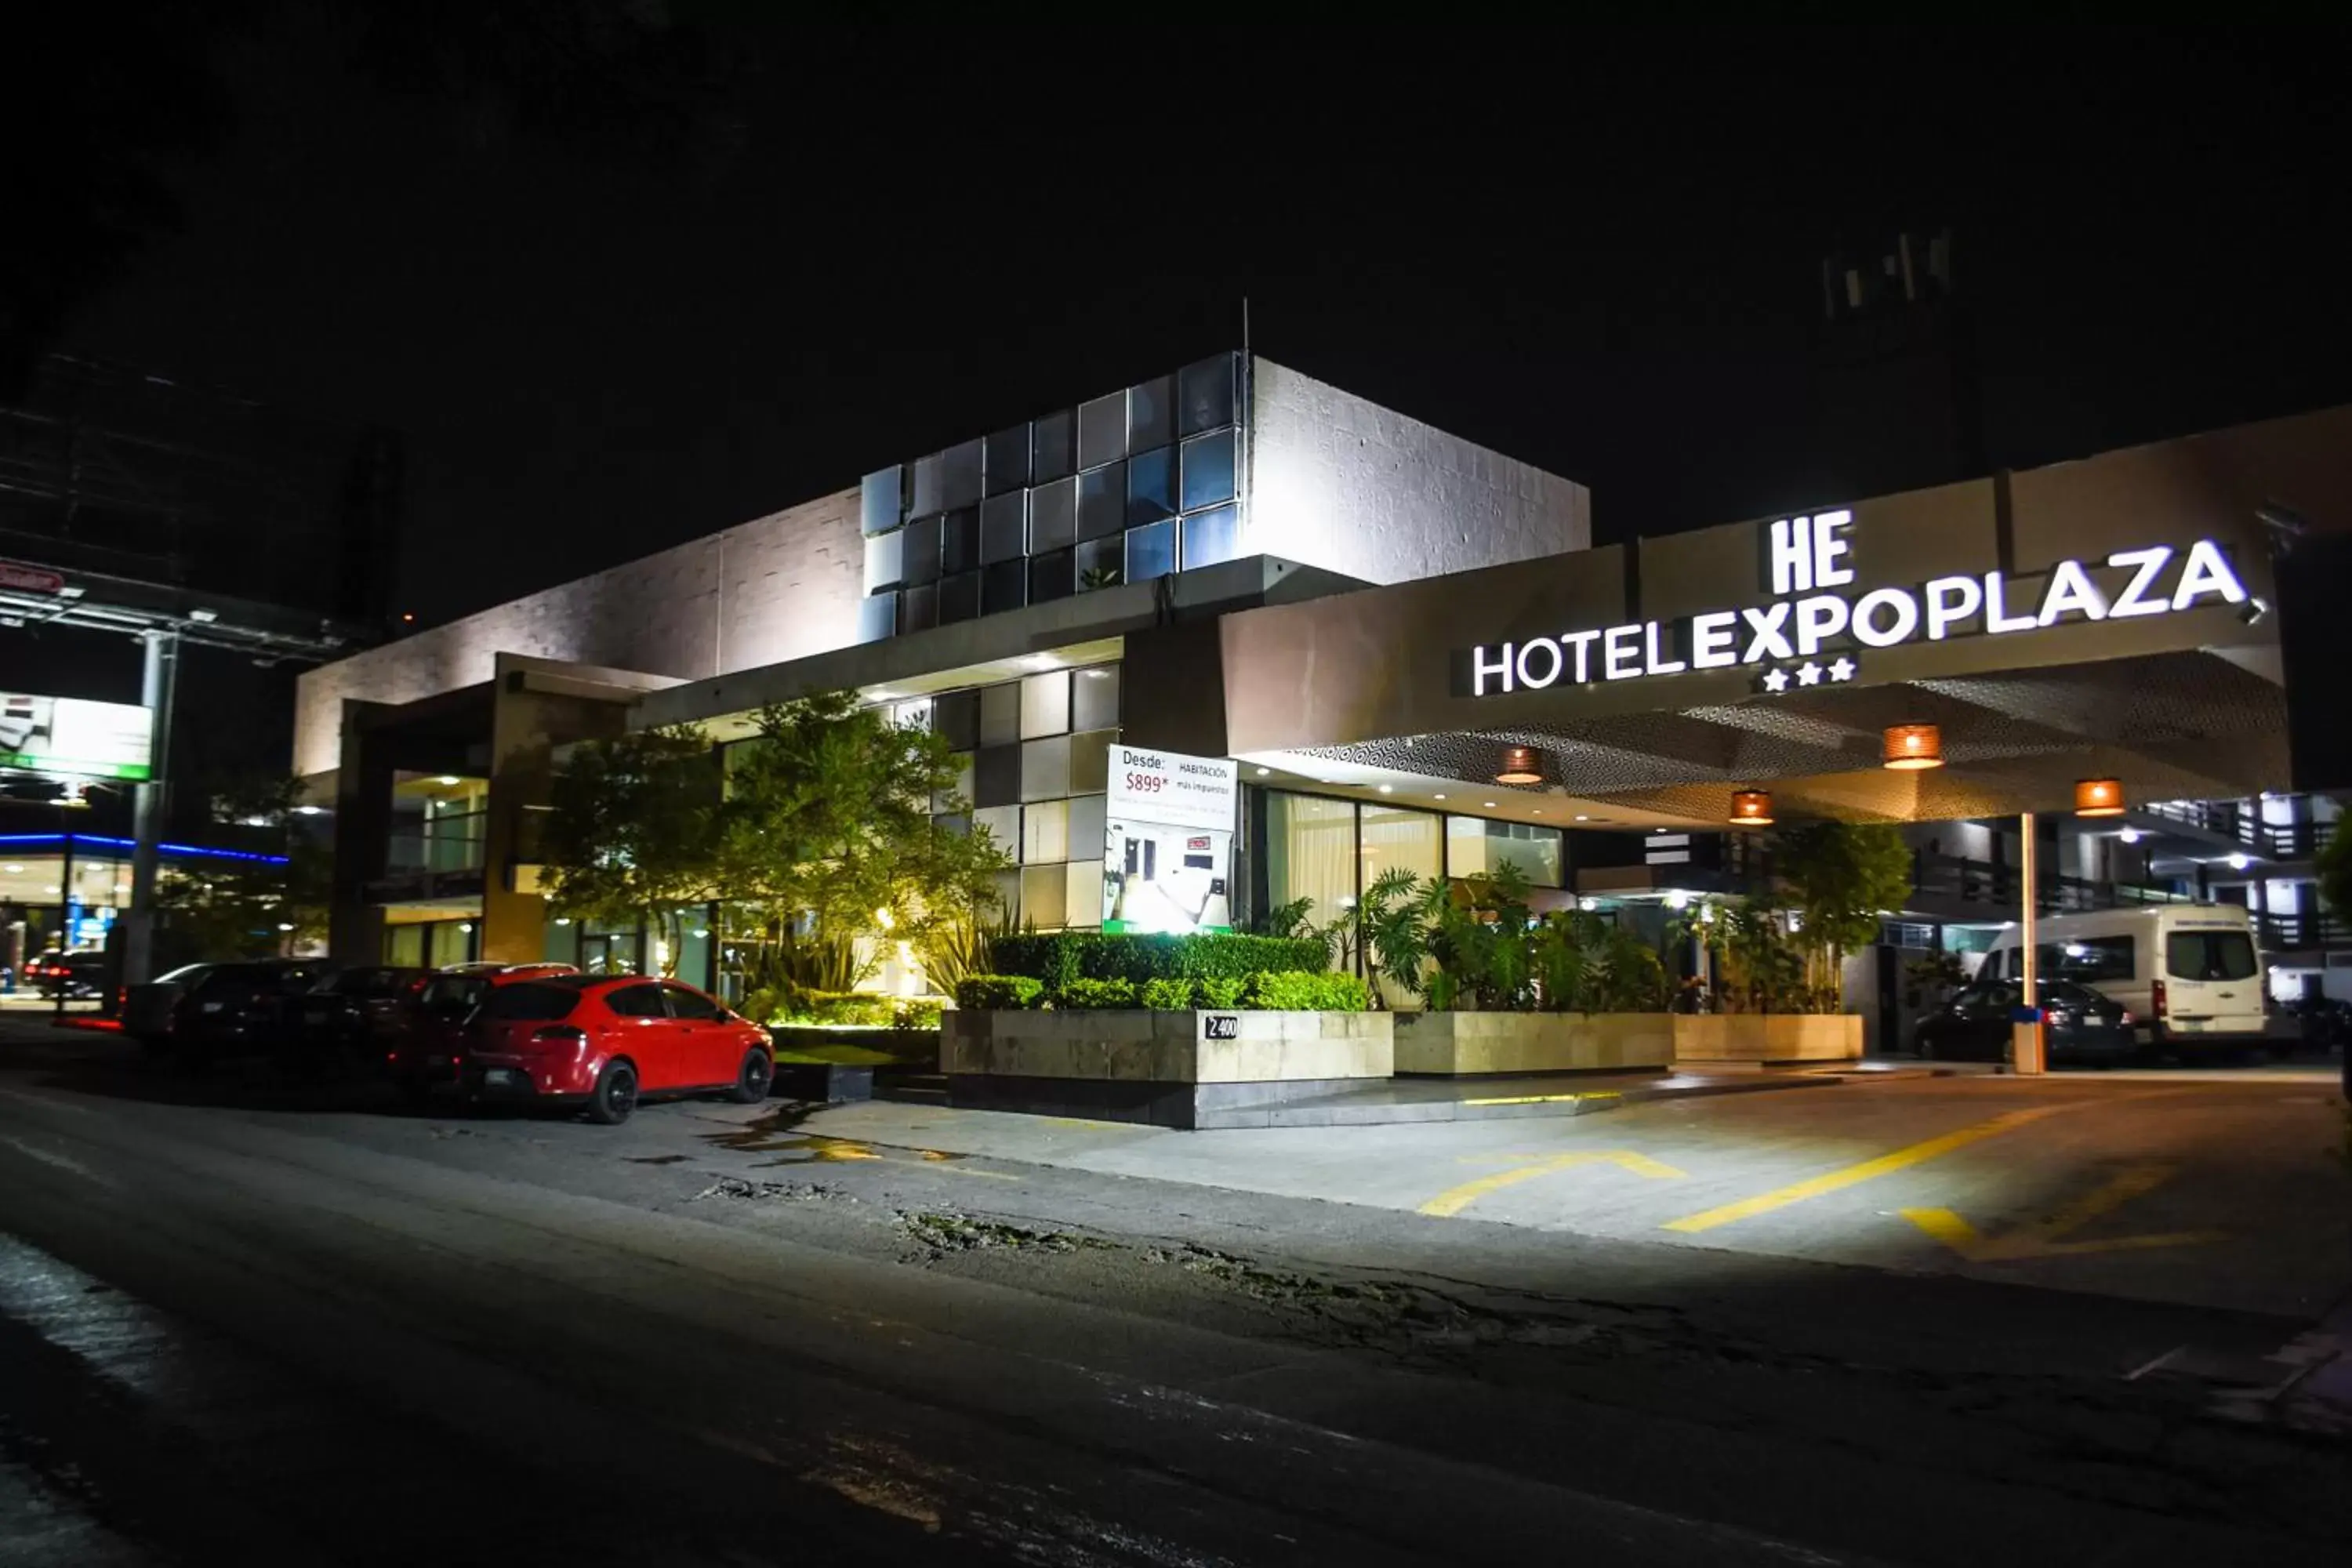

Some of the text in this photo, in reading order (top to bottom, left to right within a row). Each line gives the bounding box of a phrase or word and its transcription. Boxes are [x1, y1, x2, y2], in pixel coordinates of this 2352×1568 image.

[1770, 509, 1853, 594] HE
[1473, 621, 1686, 696] HOTEL
[1123, 750, 1166, 770] Desde:
